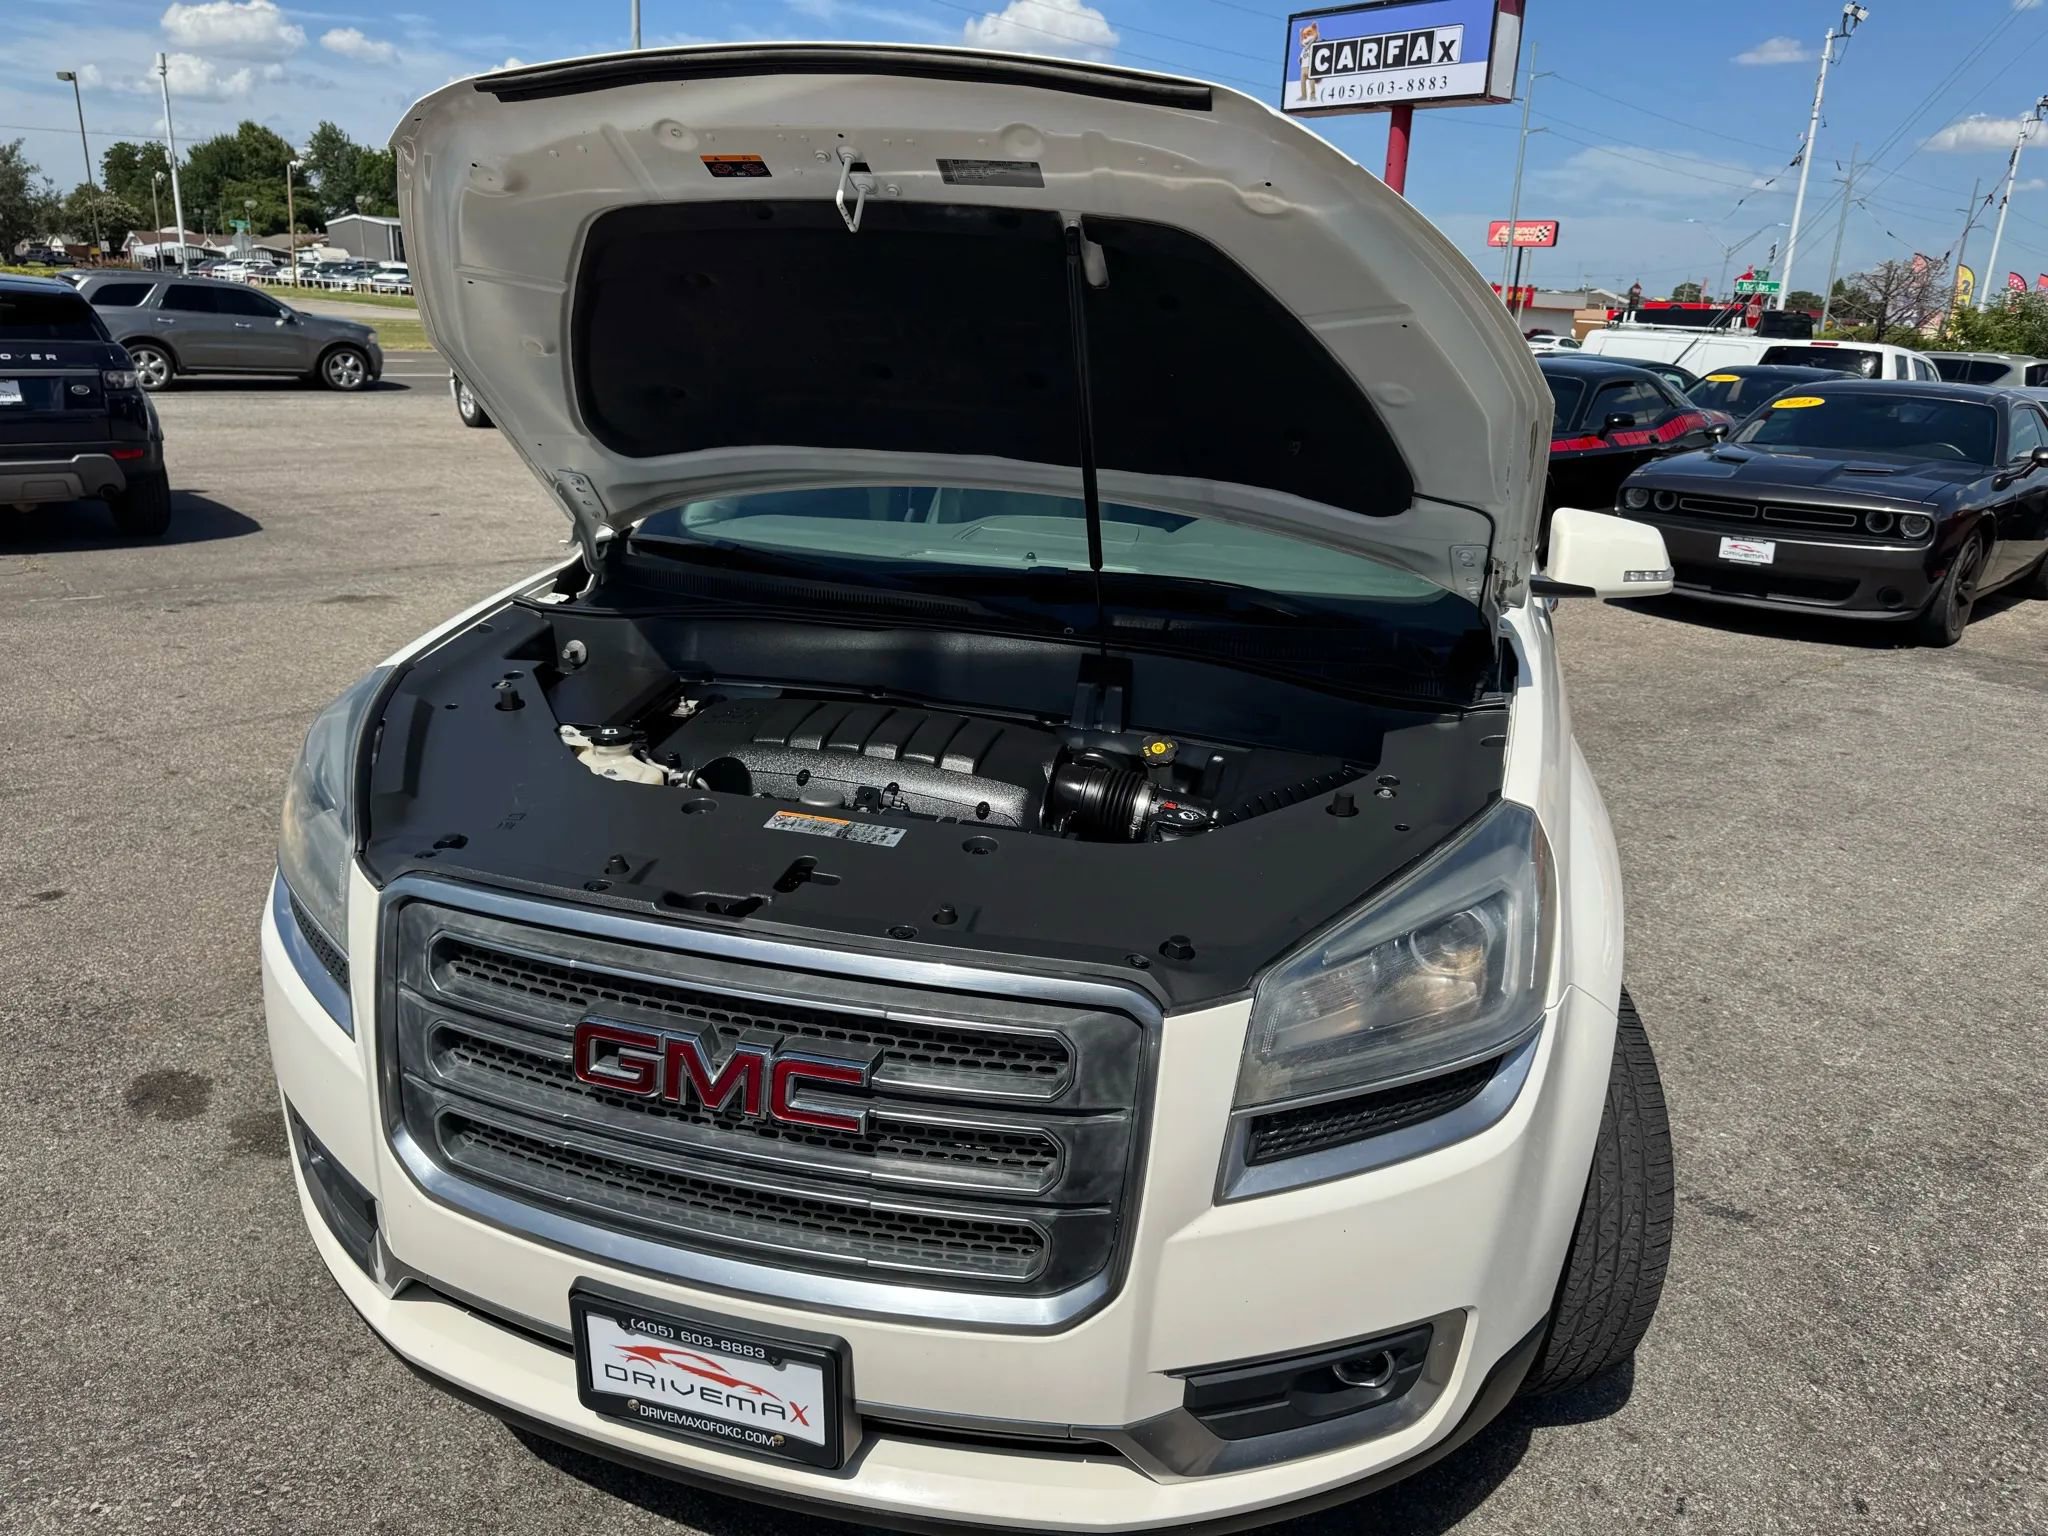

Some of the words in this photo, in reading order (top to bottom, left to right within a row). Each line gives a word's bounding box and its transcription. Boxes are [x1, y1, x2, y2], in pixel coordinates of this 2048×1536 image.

[1313, 36, 1457, 72] CARFAX
[1319, 75, 1449, 103] (405)603-8883
[573, 1012, 874, 1135] GMC
[630, 1317, 675, 1339] (405)
[680, 1330, 767, 1360] 603-8883
[605, 1363, 810, 1428] DRIVEMAX
[639, 1404, 776, 1448] DRIVEMAXOFOKC.COM
